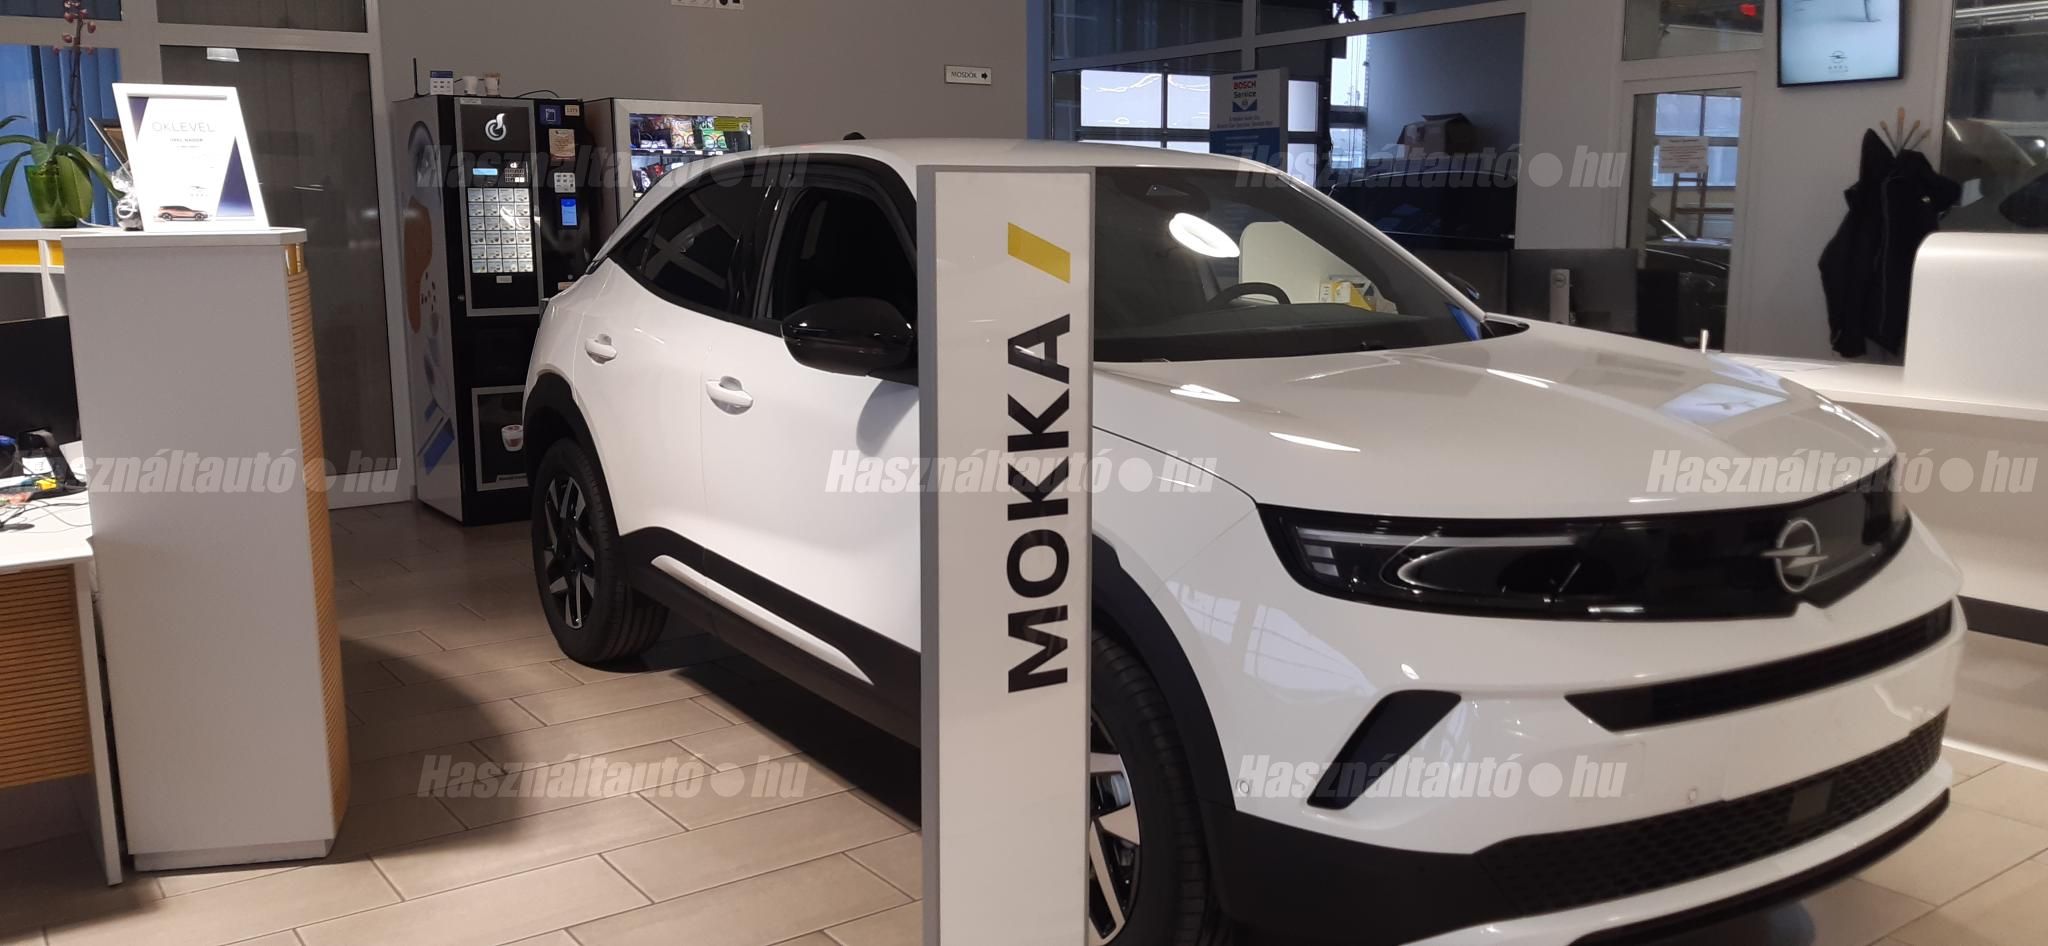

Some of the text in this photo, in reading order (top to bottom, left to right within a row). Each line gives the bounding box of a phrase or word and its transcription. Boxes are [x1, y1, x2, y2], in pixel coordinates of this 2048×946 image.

[1232, 80, 1257, 90] BOSCH
[1232, 91, 1257, 99] Service
[1007, 313, 1070, 693] MOKKA
